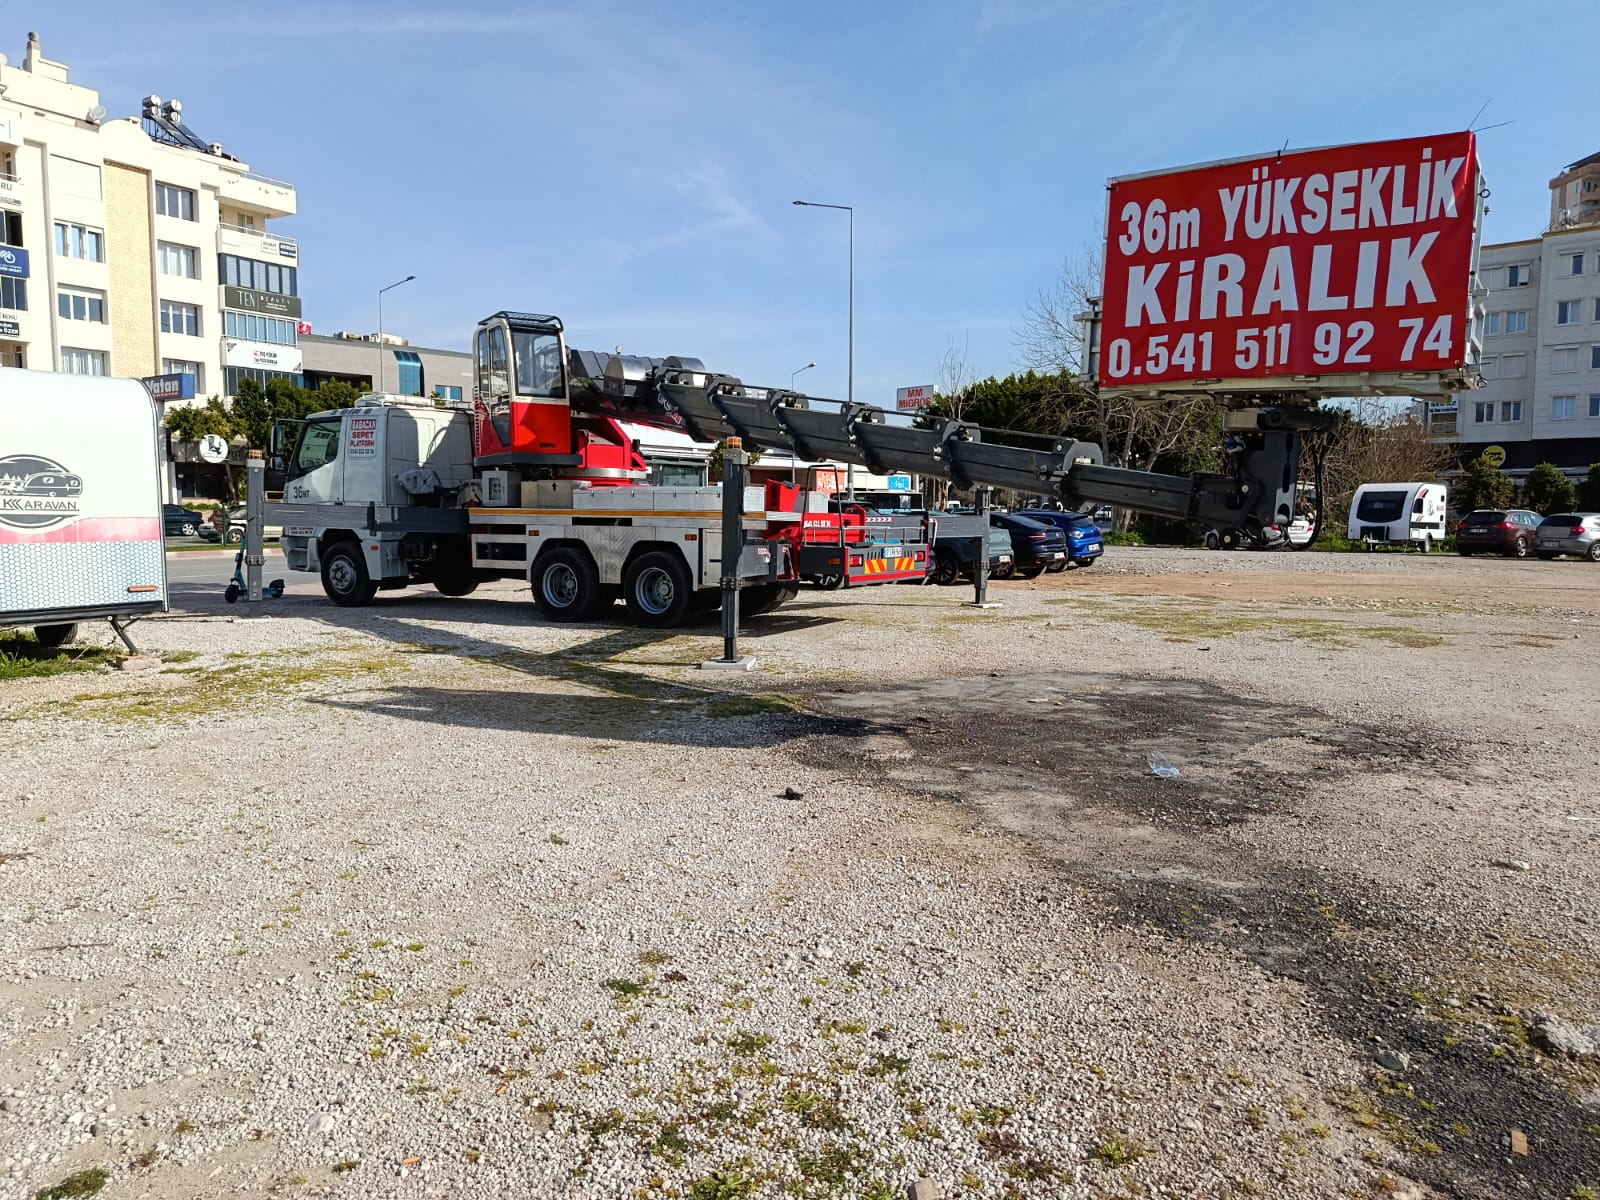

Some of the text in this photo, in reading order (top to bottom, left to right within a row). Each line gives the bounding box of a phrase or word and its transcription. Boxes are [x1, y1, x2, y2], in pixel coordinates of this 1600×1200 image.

[1119, 147, 1466, 255] 36m YÜKSEKLİK
[237, 289, 256, 307] TEN
[260, 295, 291, 305] BEAUTY
[1109, 315, 1453, 377] 0.541 511 92 74
[907, 388, 923, 398] MM
[351, 431, 375, 439] SEPET
[350, 439, 375, 448] PLATFORM
